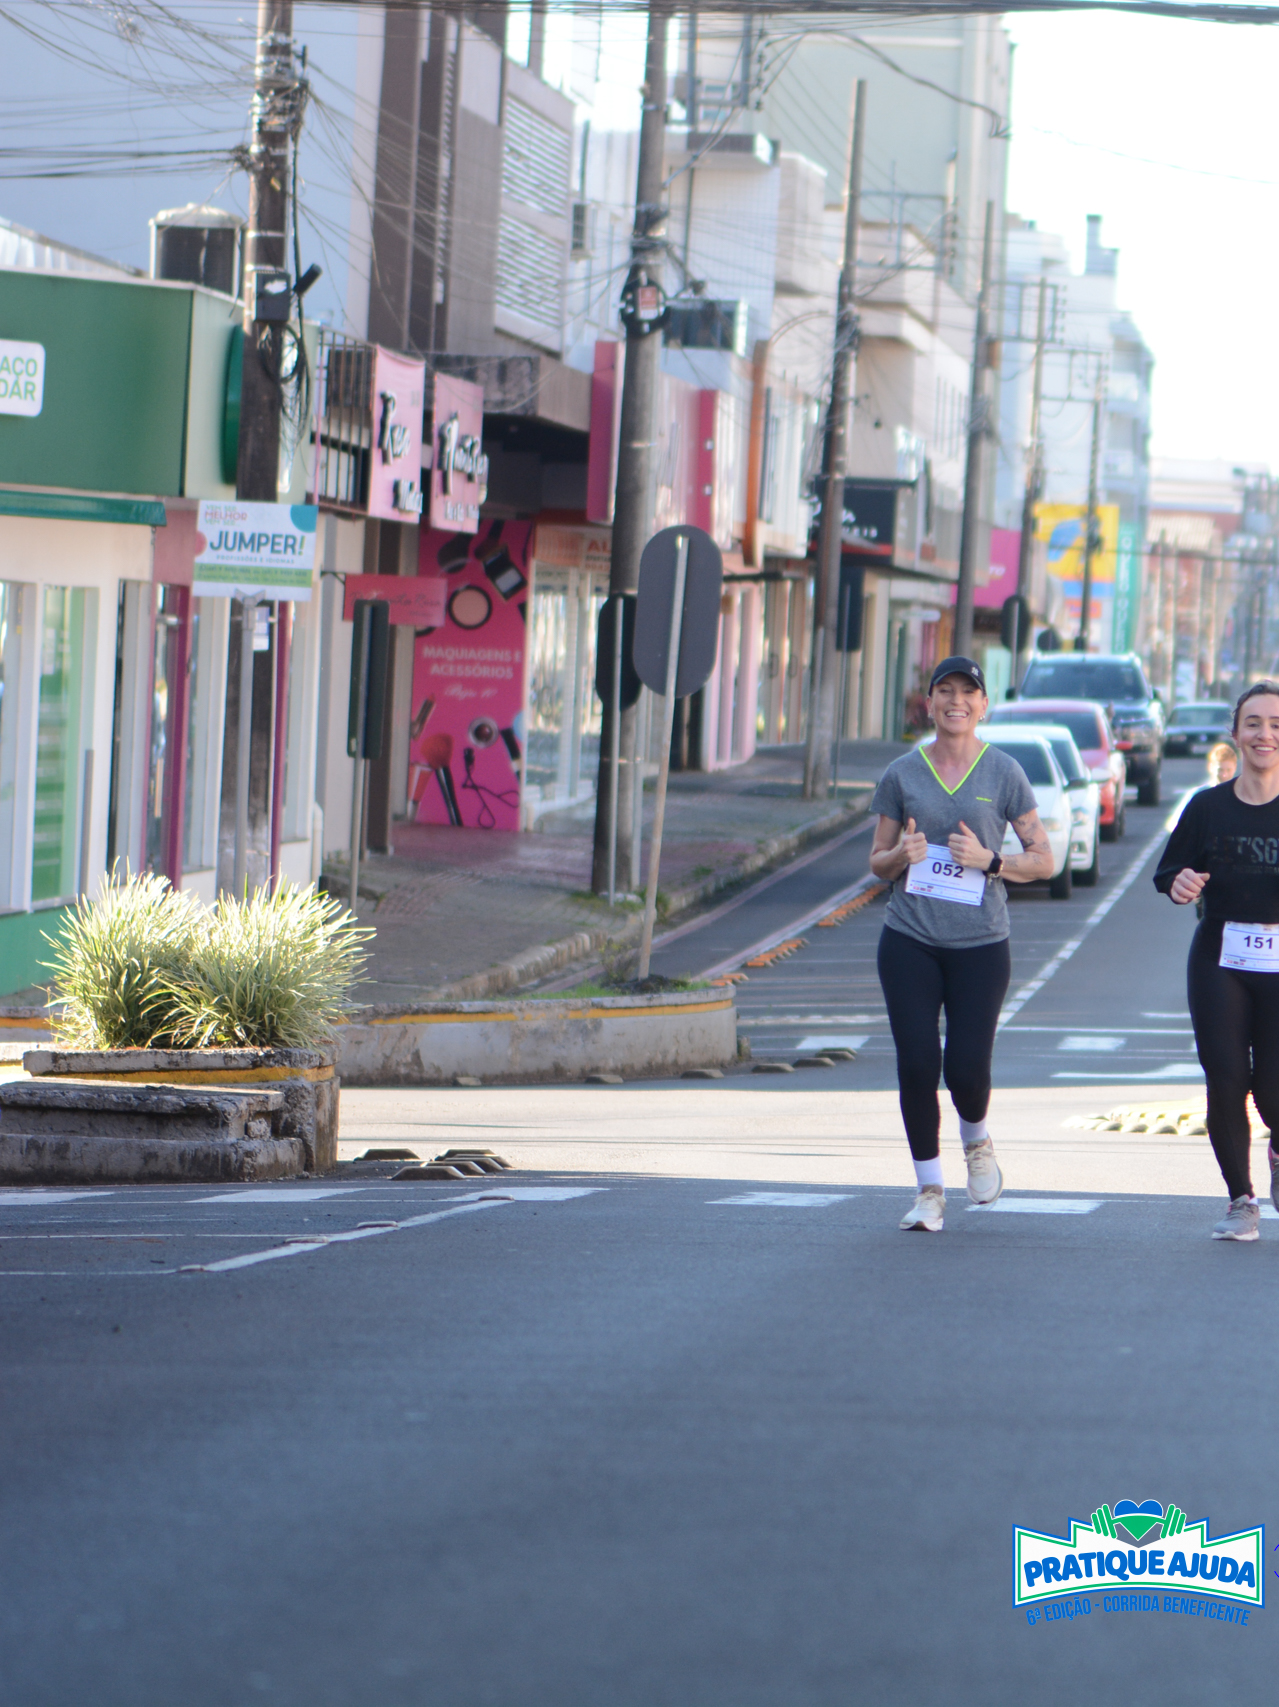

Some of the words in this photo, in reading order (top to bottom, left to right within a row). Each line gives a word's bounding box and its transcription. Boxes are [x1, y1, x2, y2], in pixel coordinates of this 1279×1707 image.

[205, 511, 248, 521] MELHOR
[210, 530, 306, 555] JUMPER!
[265, 557, 294, 565] IDIOMAS
[423, 646, 512, 662] MAQUIAGENS
[431, 663, 514, 679] ACESSÓRIOS
[932, 861, 964, 879] 052
[1244, 935, 1273, 949] 151
